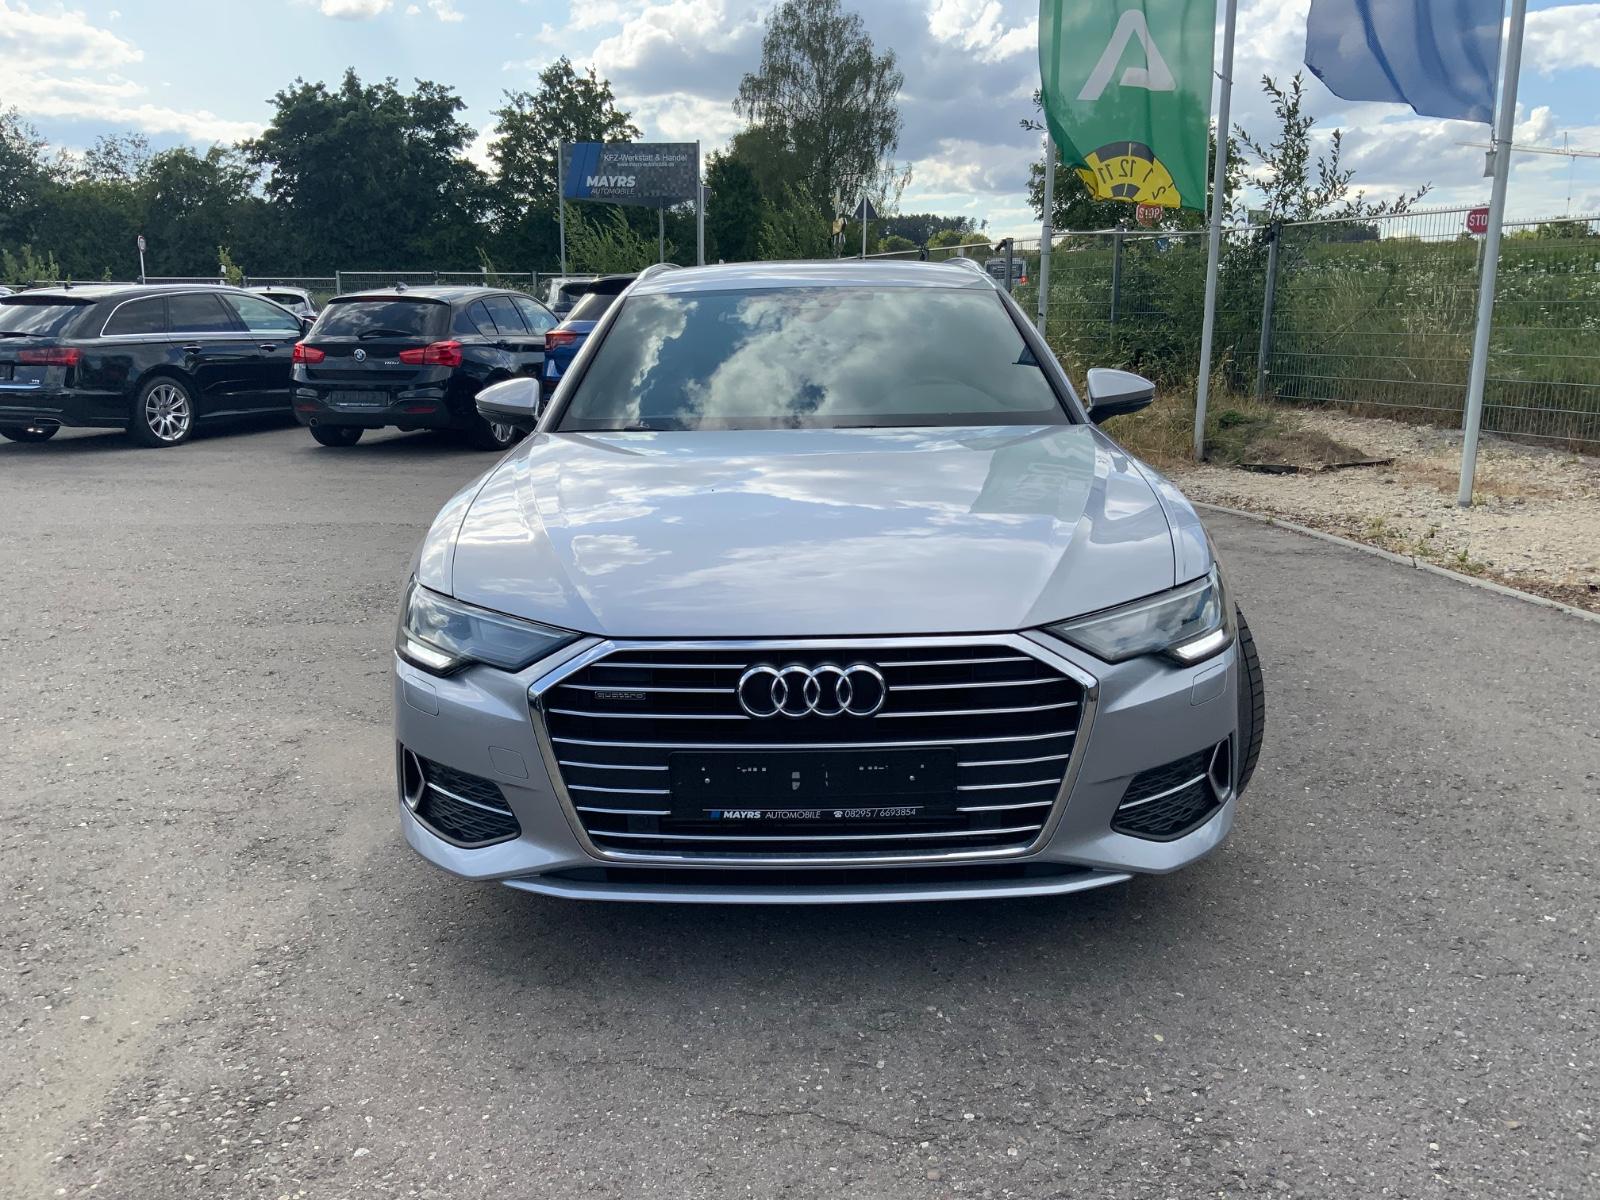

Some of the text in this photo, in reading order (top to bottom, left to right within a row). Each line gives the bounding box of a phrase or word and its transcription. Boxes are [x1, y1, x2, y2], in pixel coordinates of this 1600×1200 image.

[603, 153, 688, 161] KFZ-Werkstatt & Handel
[586, 175, 636, 188] MAYRS
[1139, 207, 1160, 219] STOP
[1469, 214, 1488, 226] STO
[723, 810, 761, 819] MAYRS
[765, 810, 821, 819] AUTOMOBILE
[844, 809, 871, 818] 08295
[880, 808, 916, 817] 6693854
